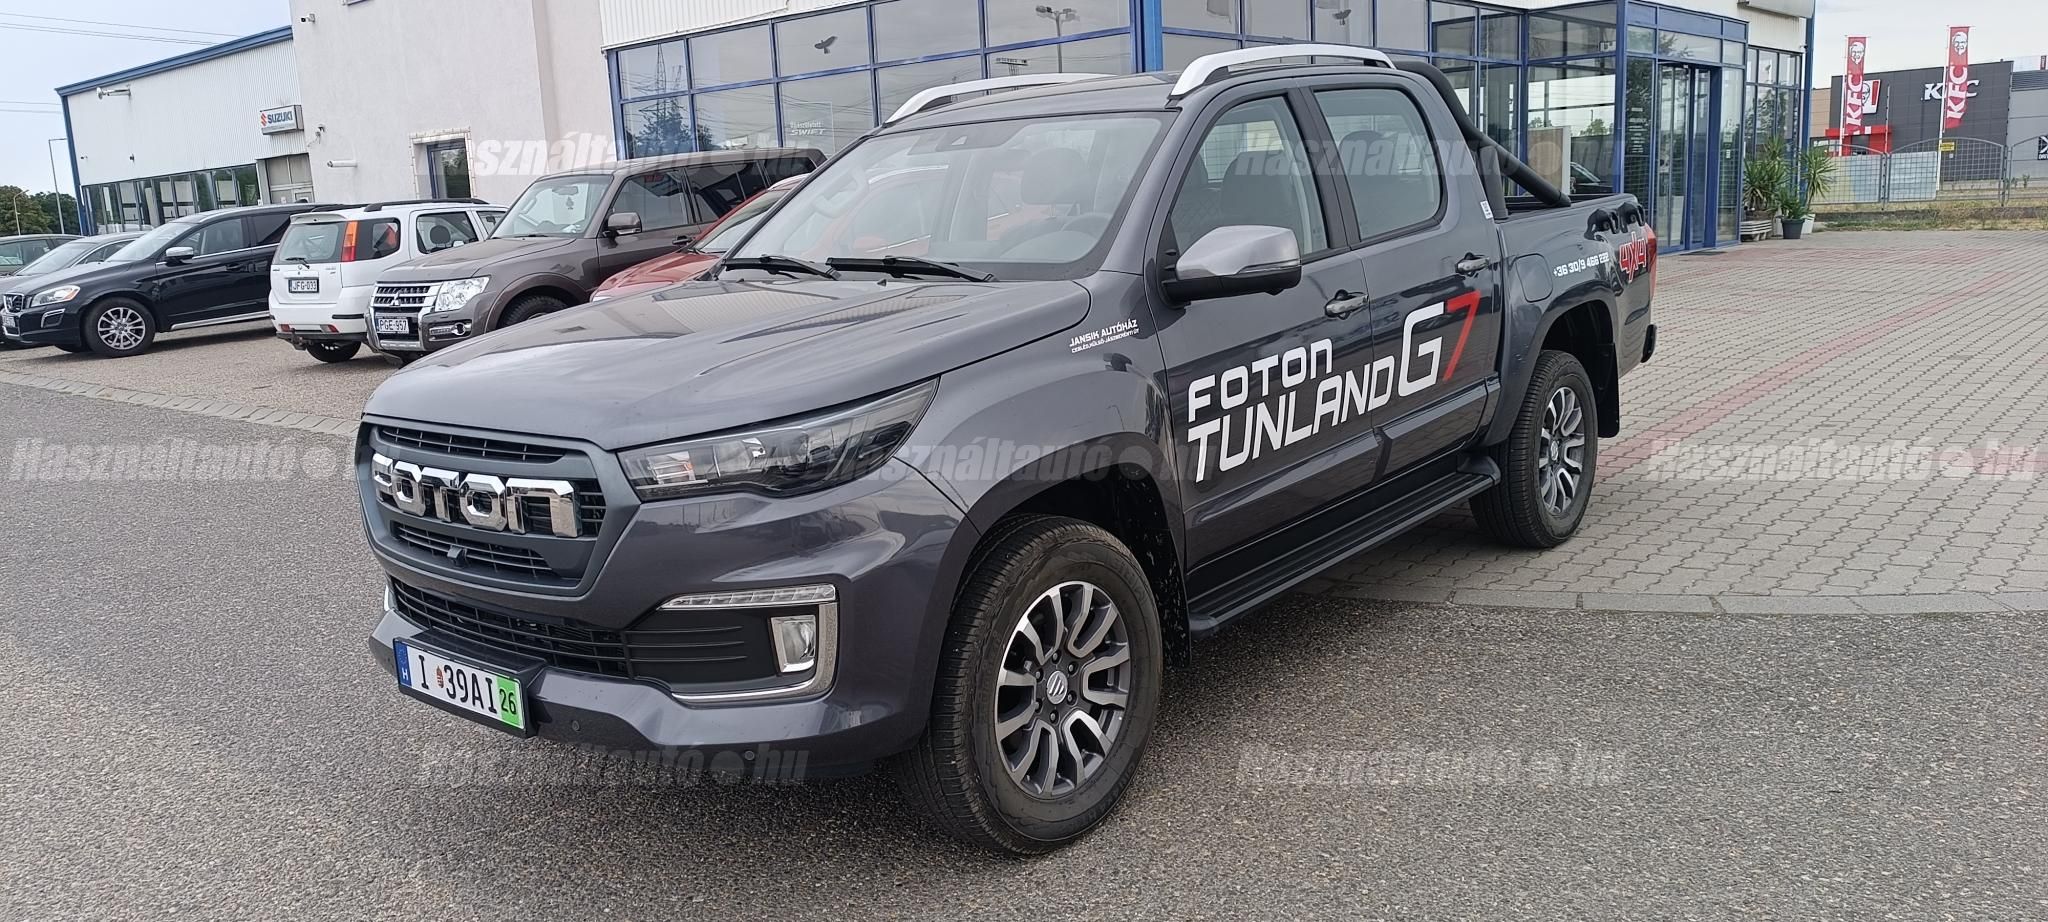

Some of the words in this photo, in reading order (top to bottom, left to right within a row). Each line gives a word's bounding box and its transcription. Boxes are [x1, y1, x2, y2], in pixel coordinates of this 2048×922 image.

[1846, 74, 1863, 126] KFC
[1924, 80, 1979, 100] KC
[1947, 64, 1968, 119] KFC
[267, 111, 293, 124] SUZUKI
[790, 128, 826, 136] SWIFT
[1553, 264, 1568, 277] +36
[1568, 258, 1586, 272] 30/9
[1587, 255, 1600, 267] 466
[293, 281, 317, 290] JFG-033
[380, 319, 407, 331] PGE-957
[1069, 330, 1100, 347] JANSIK
[1101, 318, 1138, 338] AUTÓHÁZ
[1398, 290, 1481, 397] G7
[1188, 338, 1333, 423] FOTON
[1187, 355, 1395, 483] TUNLAND
[402, 667, 409, 681] H
[499, 688, 517, 715] 26
